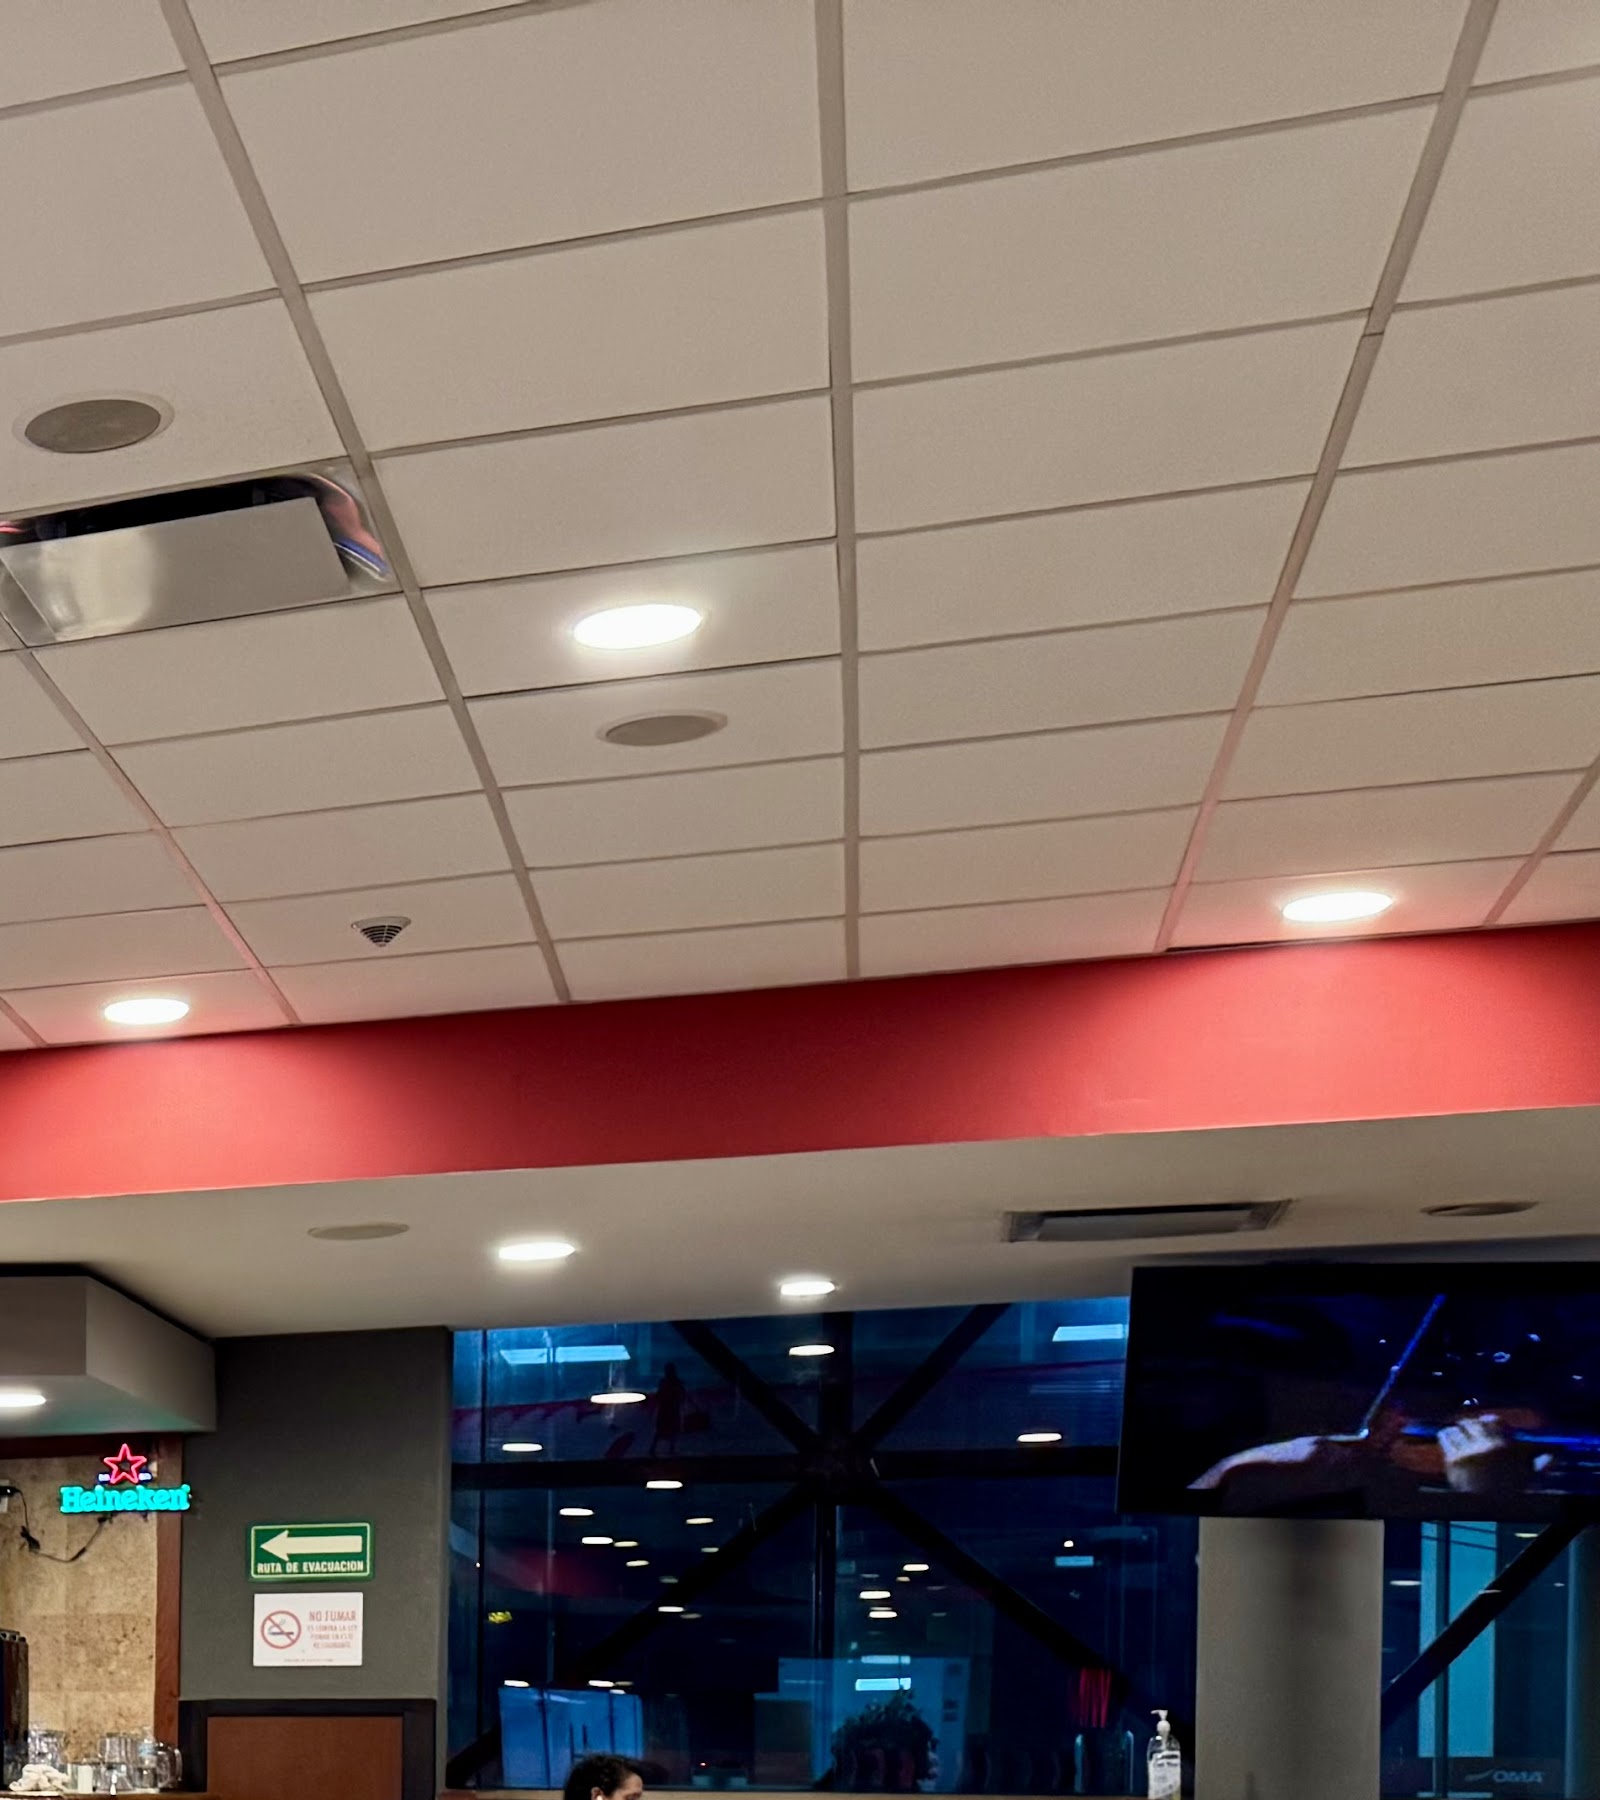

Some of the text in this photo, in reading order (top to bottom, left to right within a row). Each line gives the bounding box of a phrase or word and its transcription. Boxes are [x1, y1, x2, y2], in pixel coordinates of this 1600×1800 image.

[60, 1484, 190, 1512] Heineken
[257, 1561, 364, 1573] RUTA DE EVACUACION
[309, 1611, 322, 1621] NO
